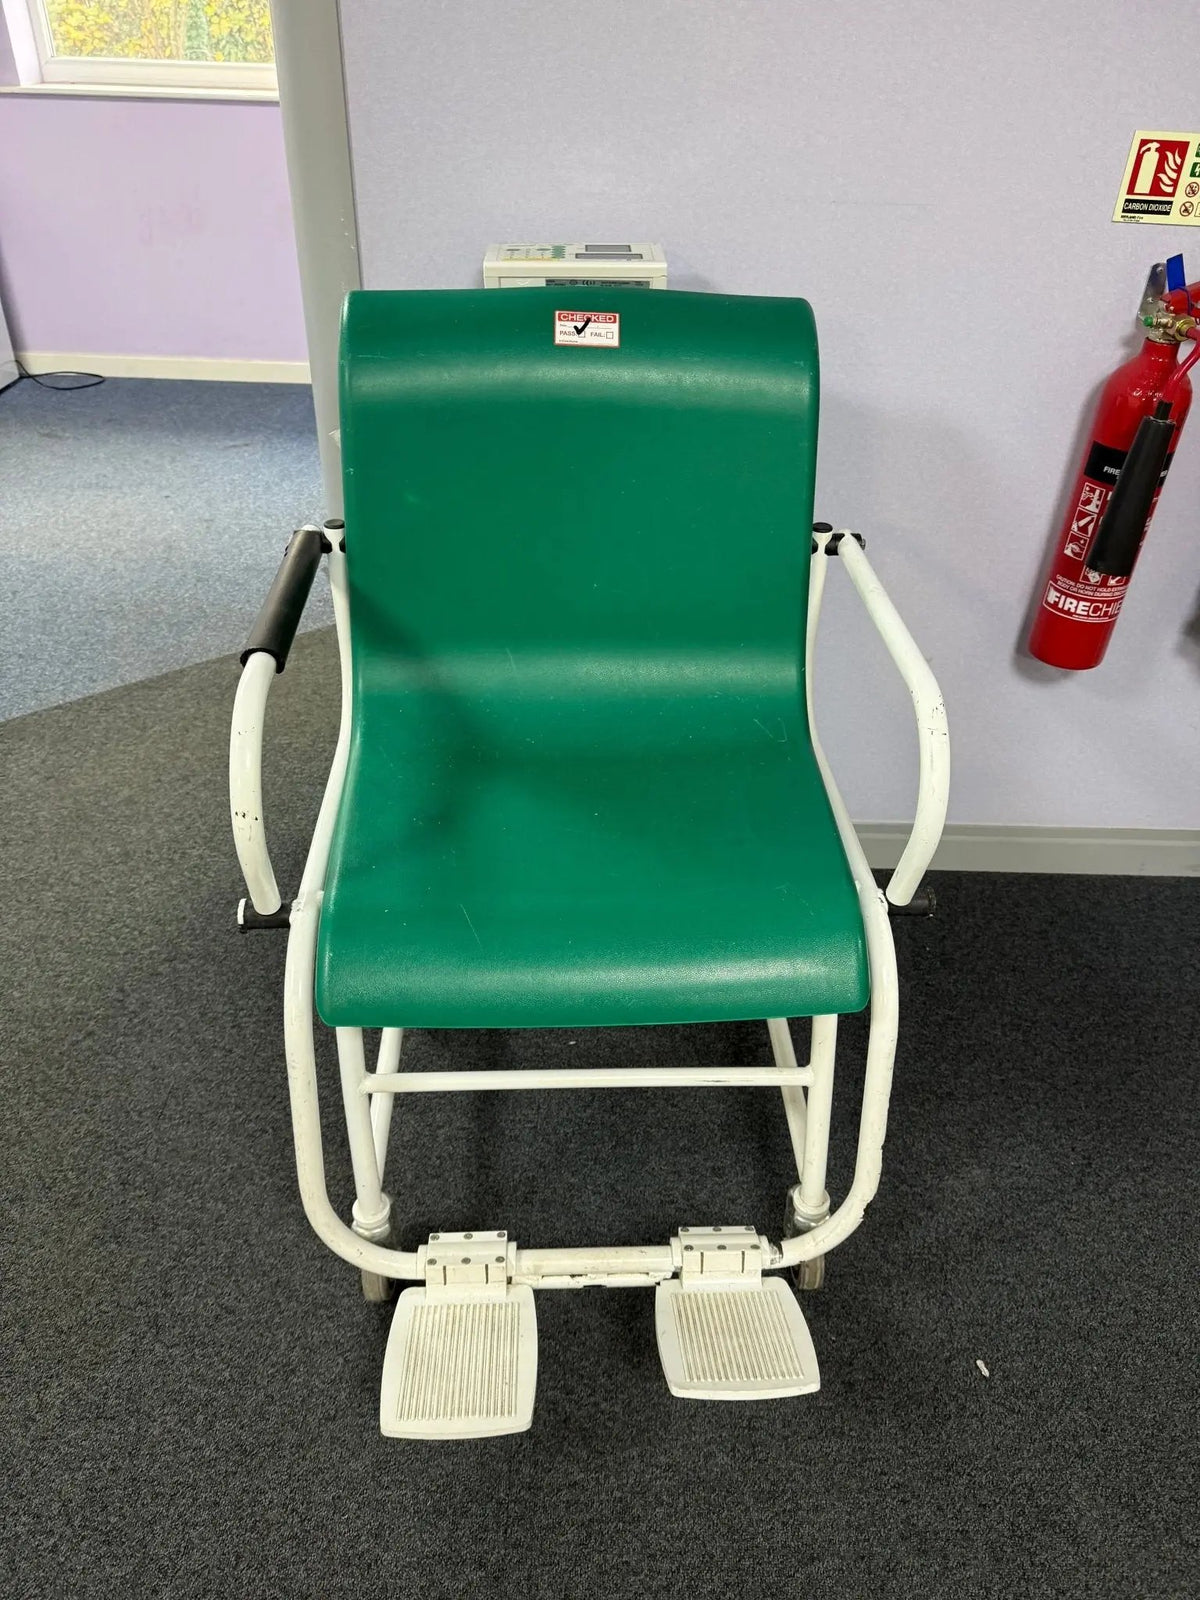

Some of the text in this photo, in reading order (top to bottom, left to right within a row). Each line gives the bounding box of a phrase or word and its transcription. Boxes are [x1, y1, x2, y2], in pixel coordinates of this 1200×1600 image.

[1124, 202, 1171, 212] CARBON DIOXIDE
[560, 313, 614, 323] CHECKED
[1103, 465, 1121, 476] FIRE
[1046, 586, 1123, 616] FIRECHIE
